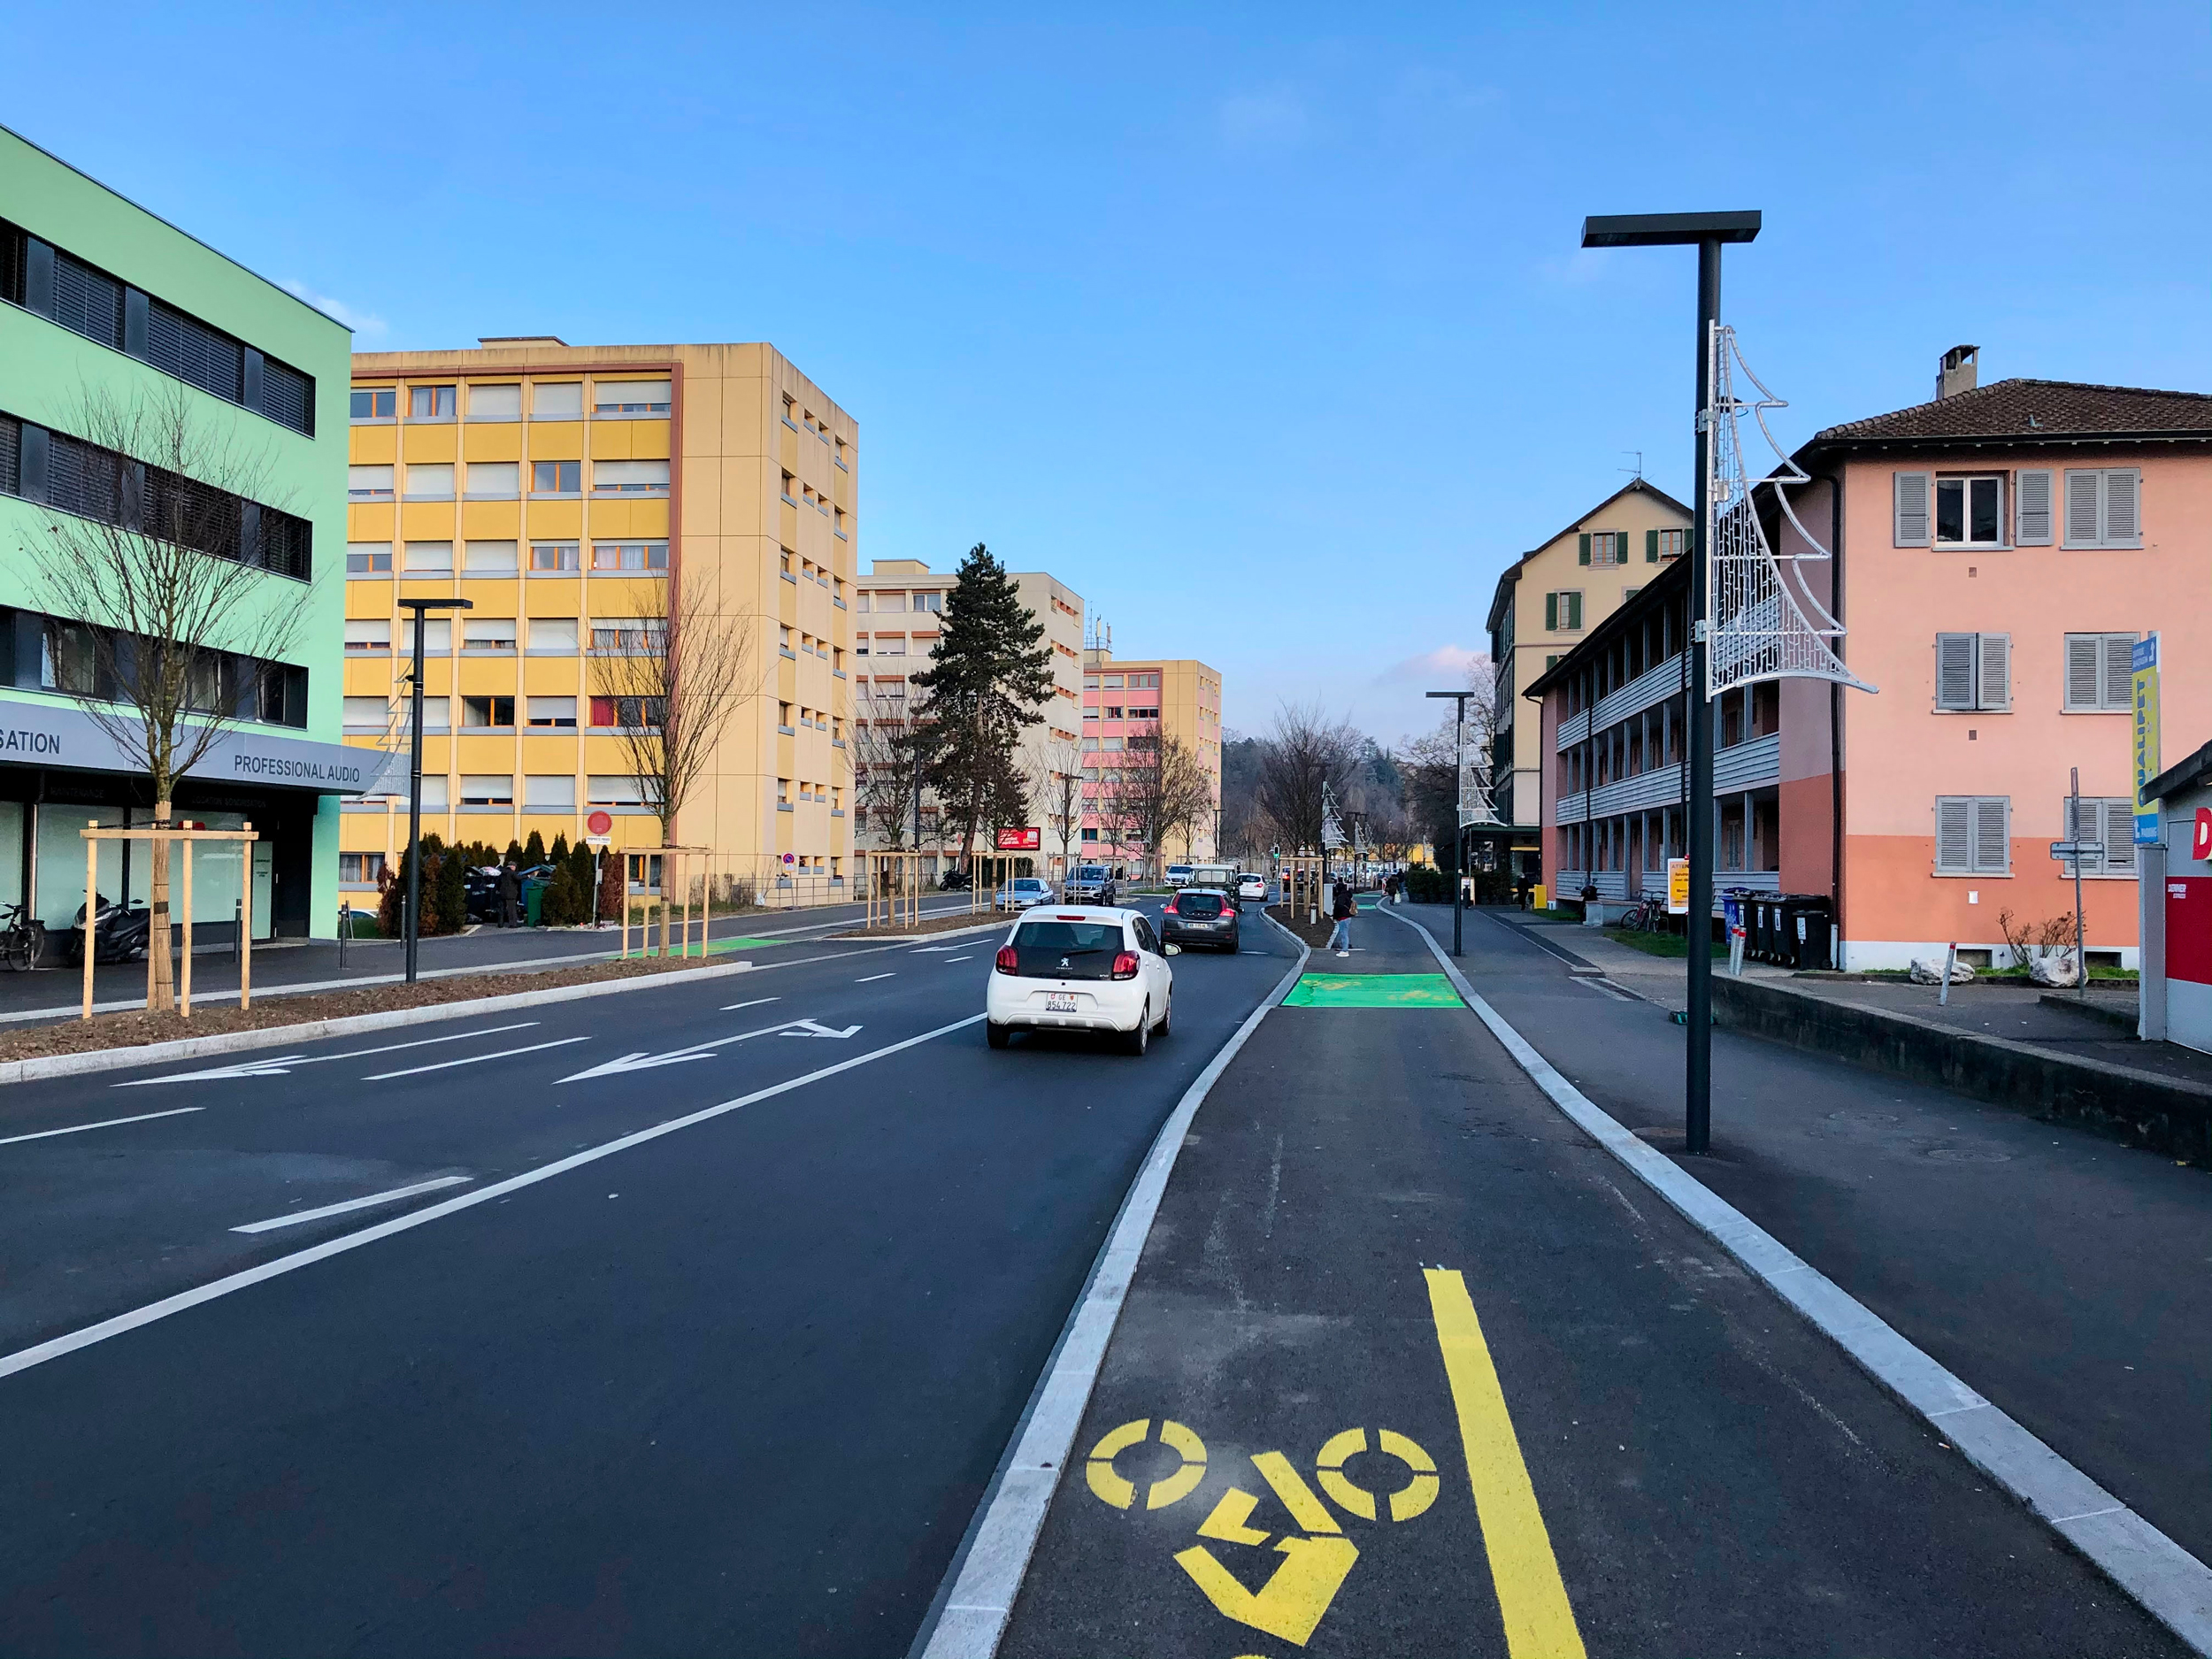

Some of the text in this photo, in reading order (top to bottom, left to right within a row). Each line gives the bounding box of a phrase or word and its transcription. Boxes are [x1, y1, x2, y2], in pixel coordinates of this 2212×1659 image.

[234, 755, 360, 783] PROFESSIONAL AUDIO
[2137, 678, 2146, 808] QUALIPET
